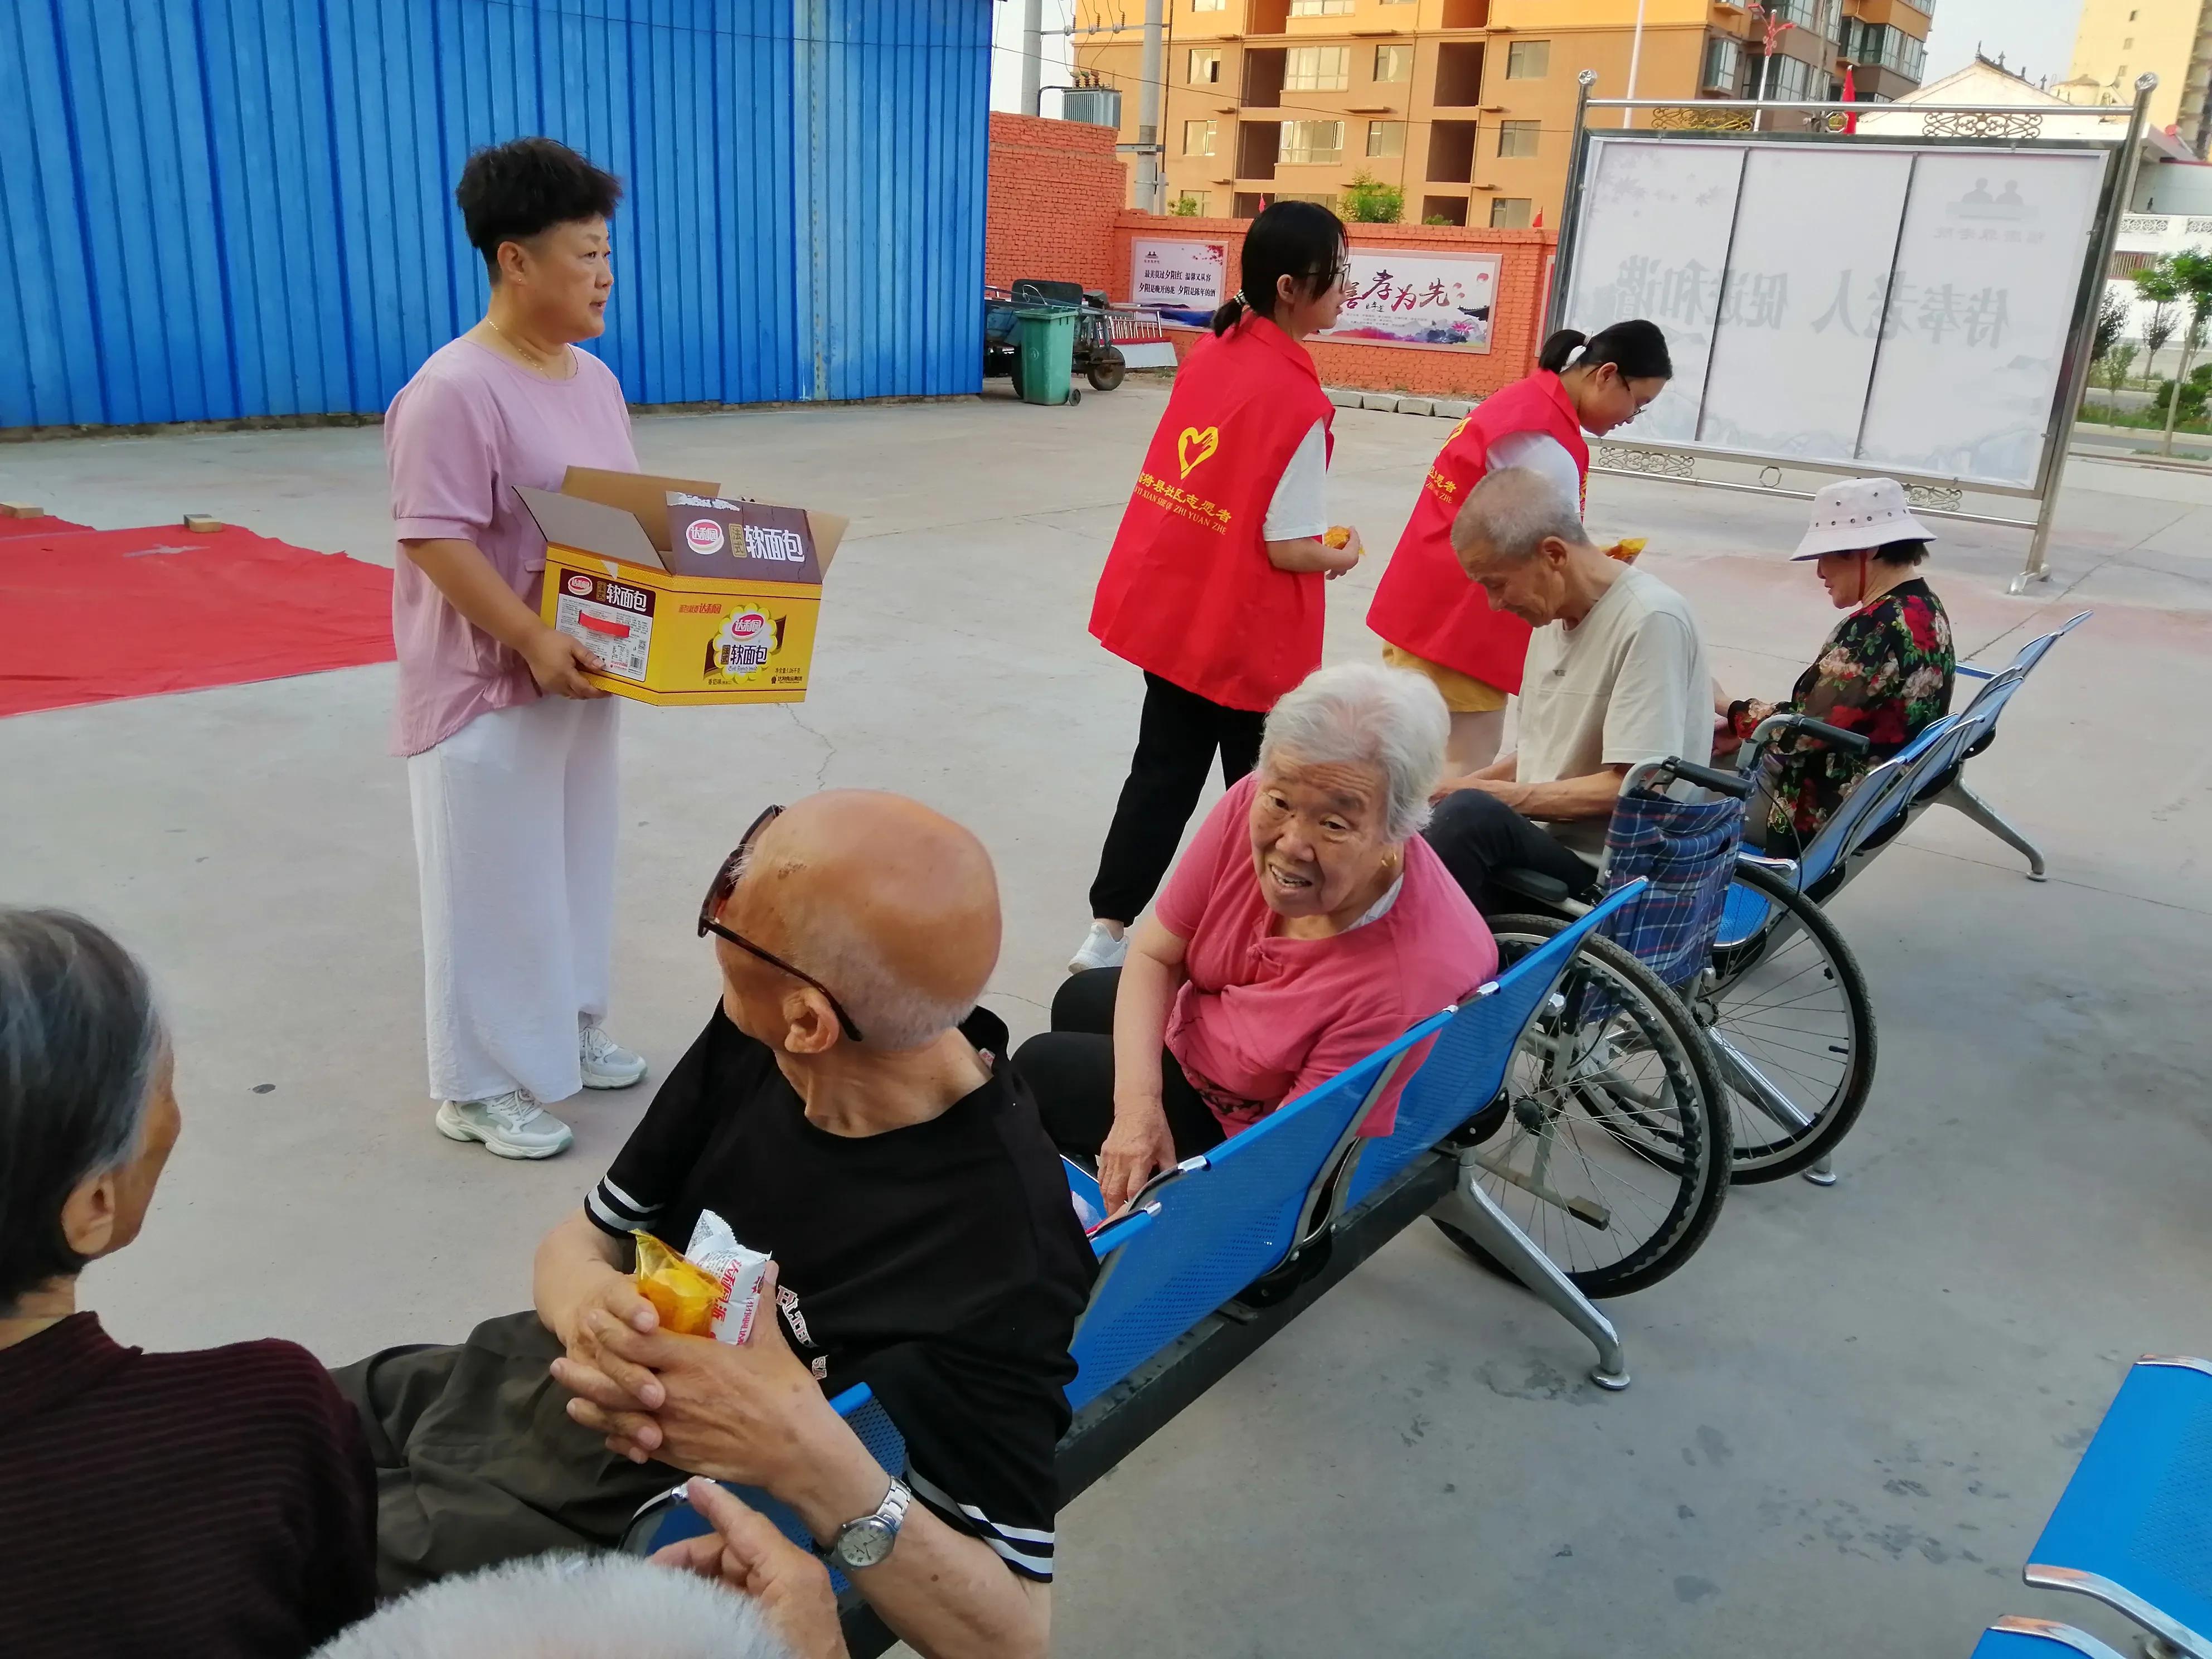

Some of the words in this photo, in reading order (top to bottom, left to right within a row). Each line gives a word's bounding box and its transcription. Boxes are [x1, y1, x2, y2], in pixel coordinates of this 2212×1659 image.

[1173, 505, 1186, 516] ZHI
[1189, 511, 1210, 526] YUAN
[1212, 522, 1226, 535] ZHE
[744, 525, 805, 562] 软面包
[607, 583, 647, 612] 软面包
[730, 644, 768, 664] 软面包
